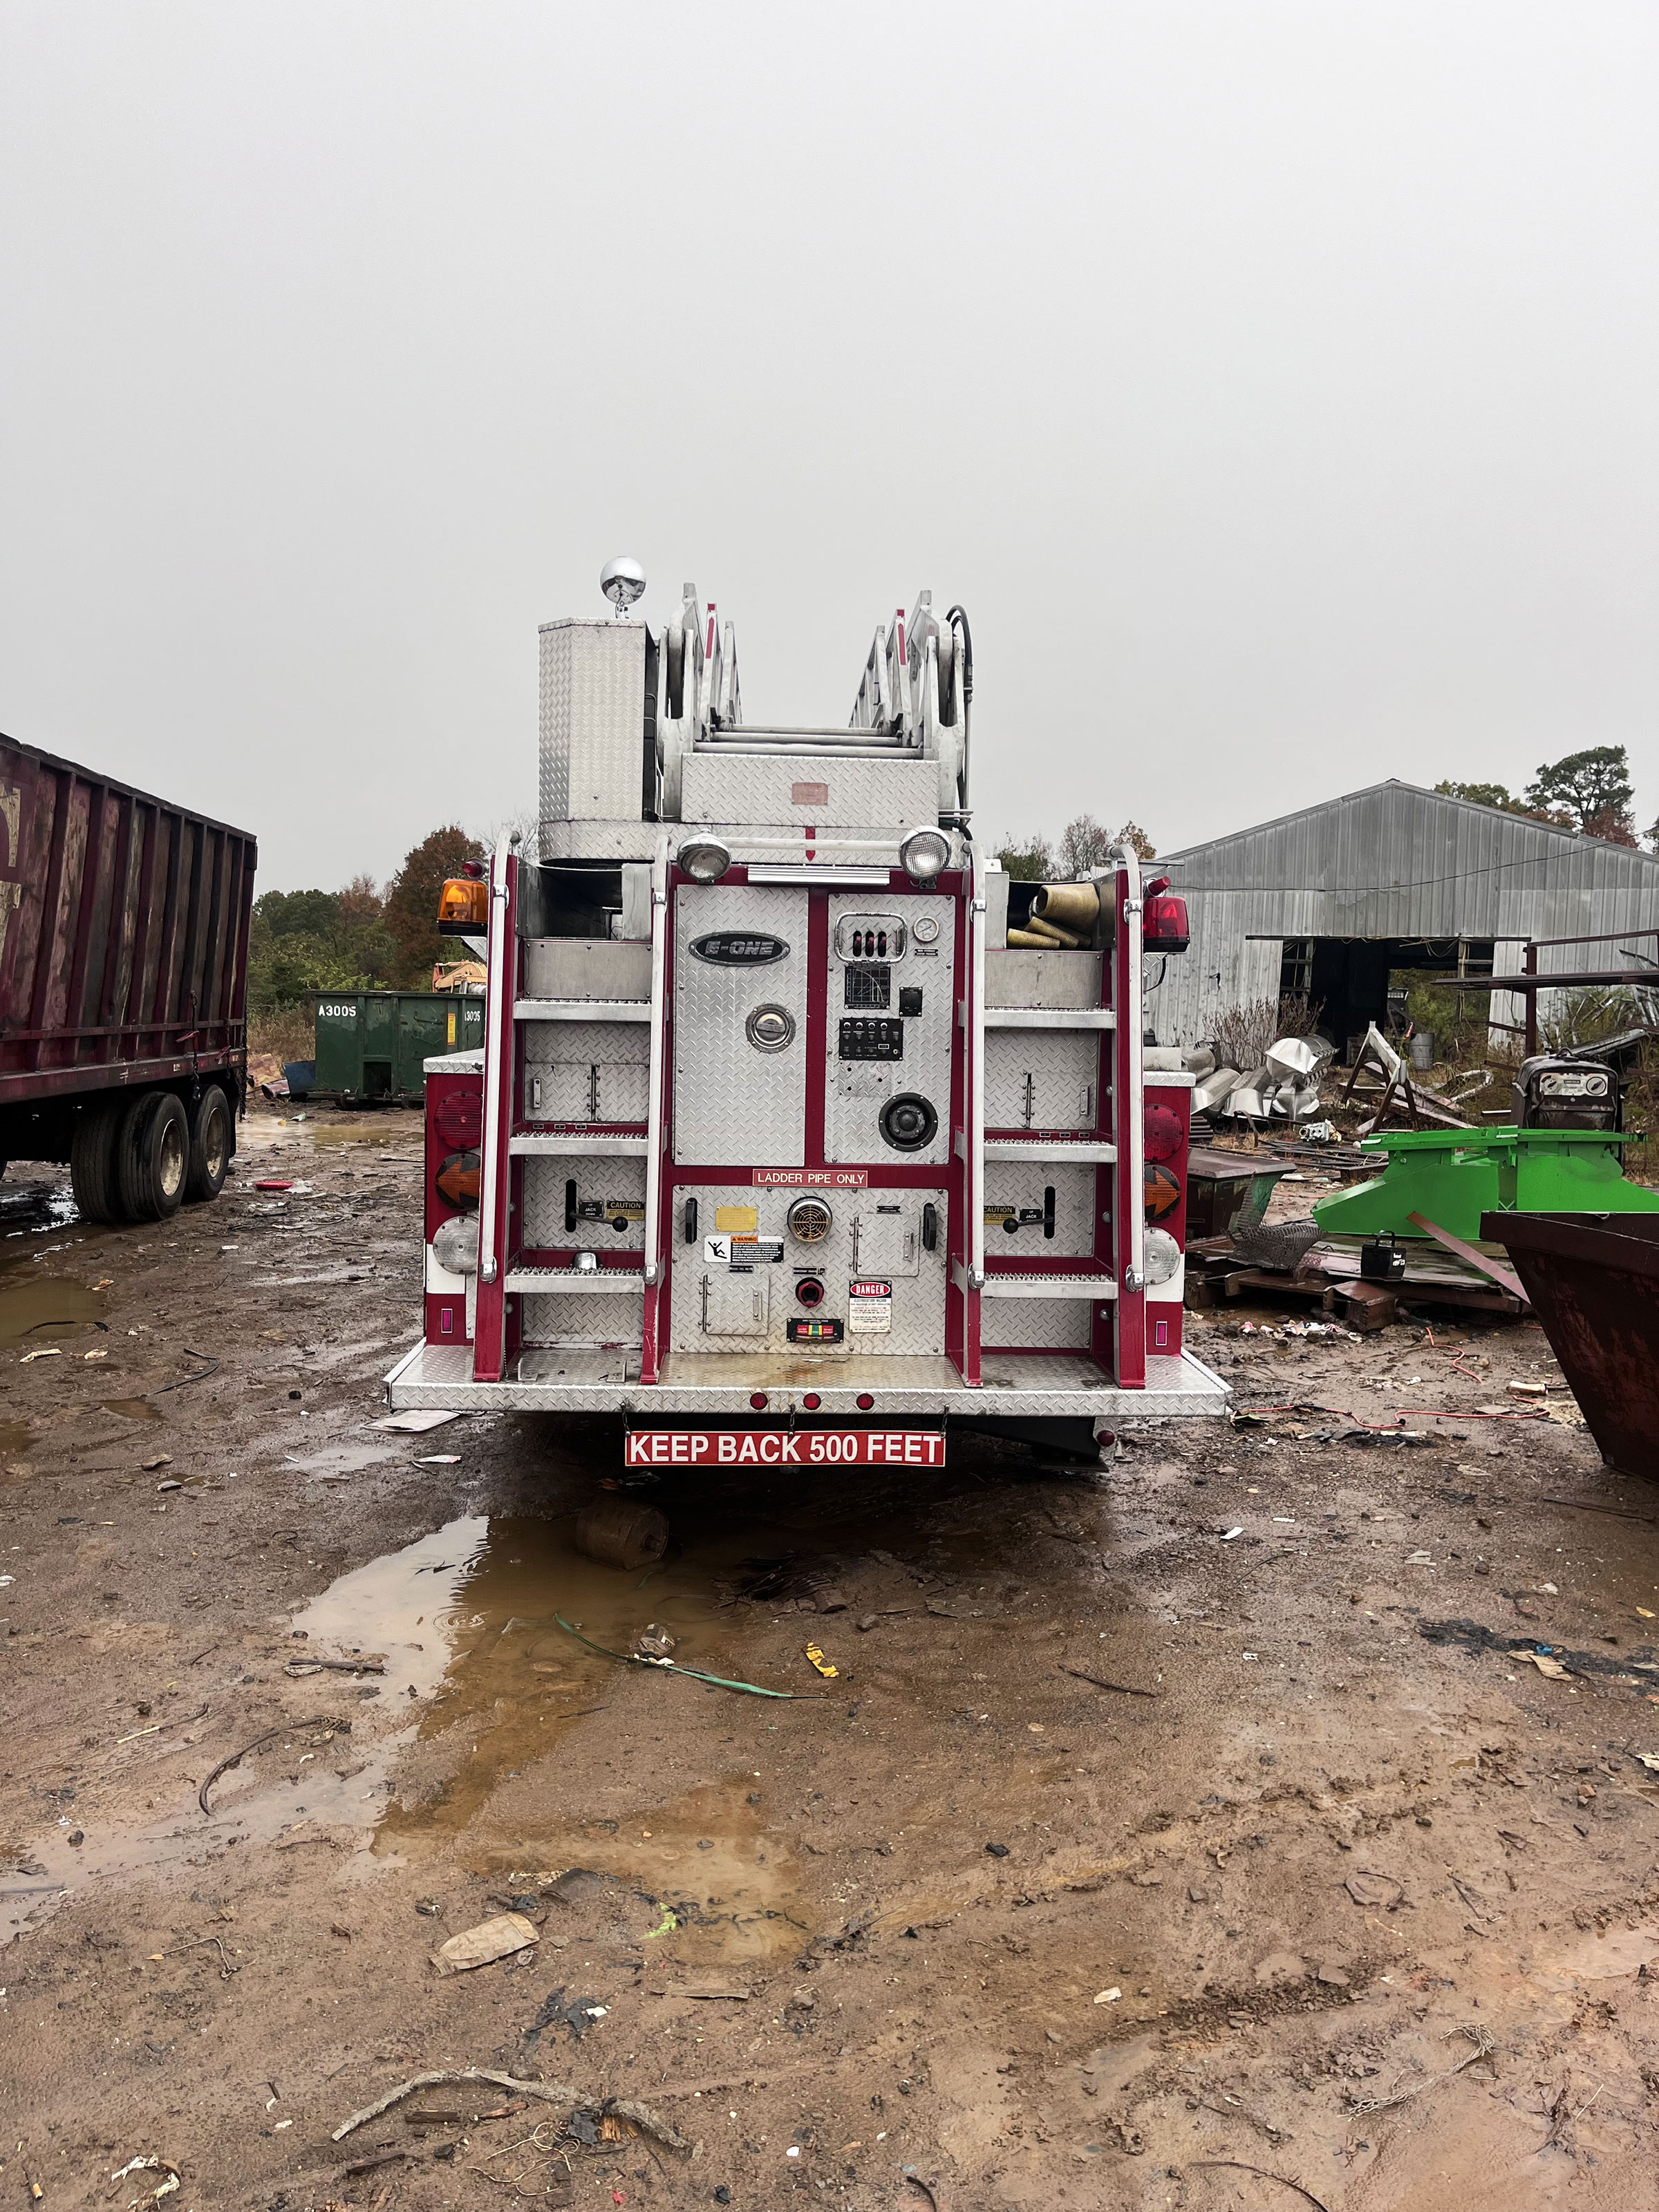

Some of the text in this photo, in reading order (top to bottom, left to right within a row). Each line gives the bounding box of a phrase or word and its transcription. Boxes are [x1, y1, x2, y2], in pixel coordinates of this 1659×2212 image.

[705, 941, 774, 955] E-ONE
[319, 1005, 357, 1017] A3005
[758, 1173, 864, 1184] LADDER PIPE ONLY
[856, 1284, 885, 1295] DANGER
[630, 1434, 941, 1463] KEEP BACK 500 FEET
